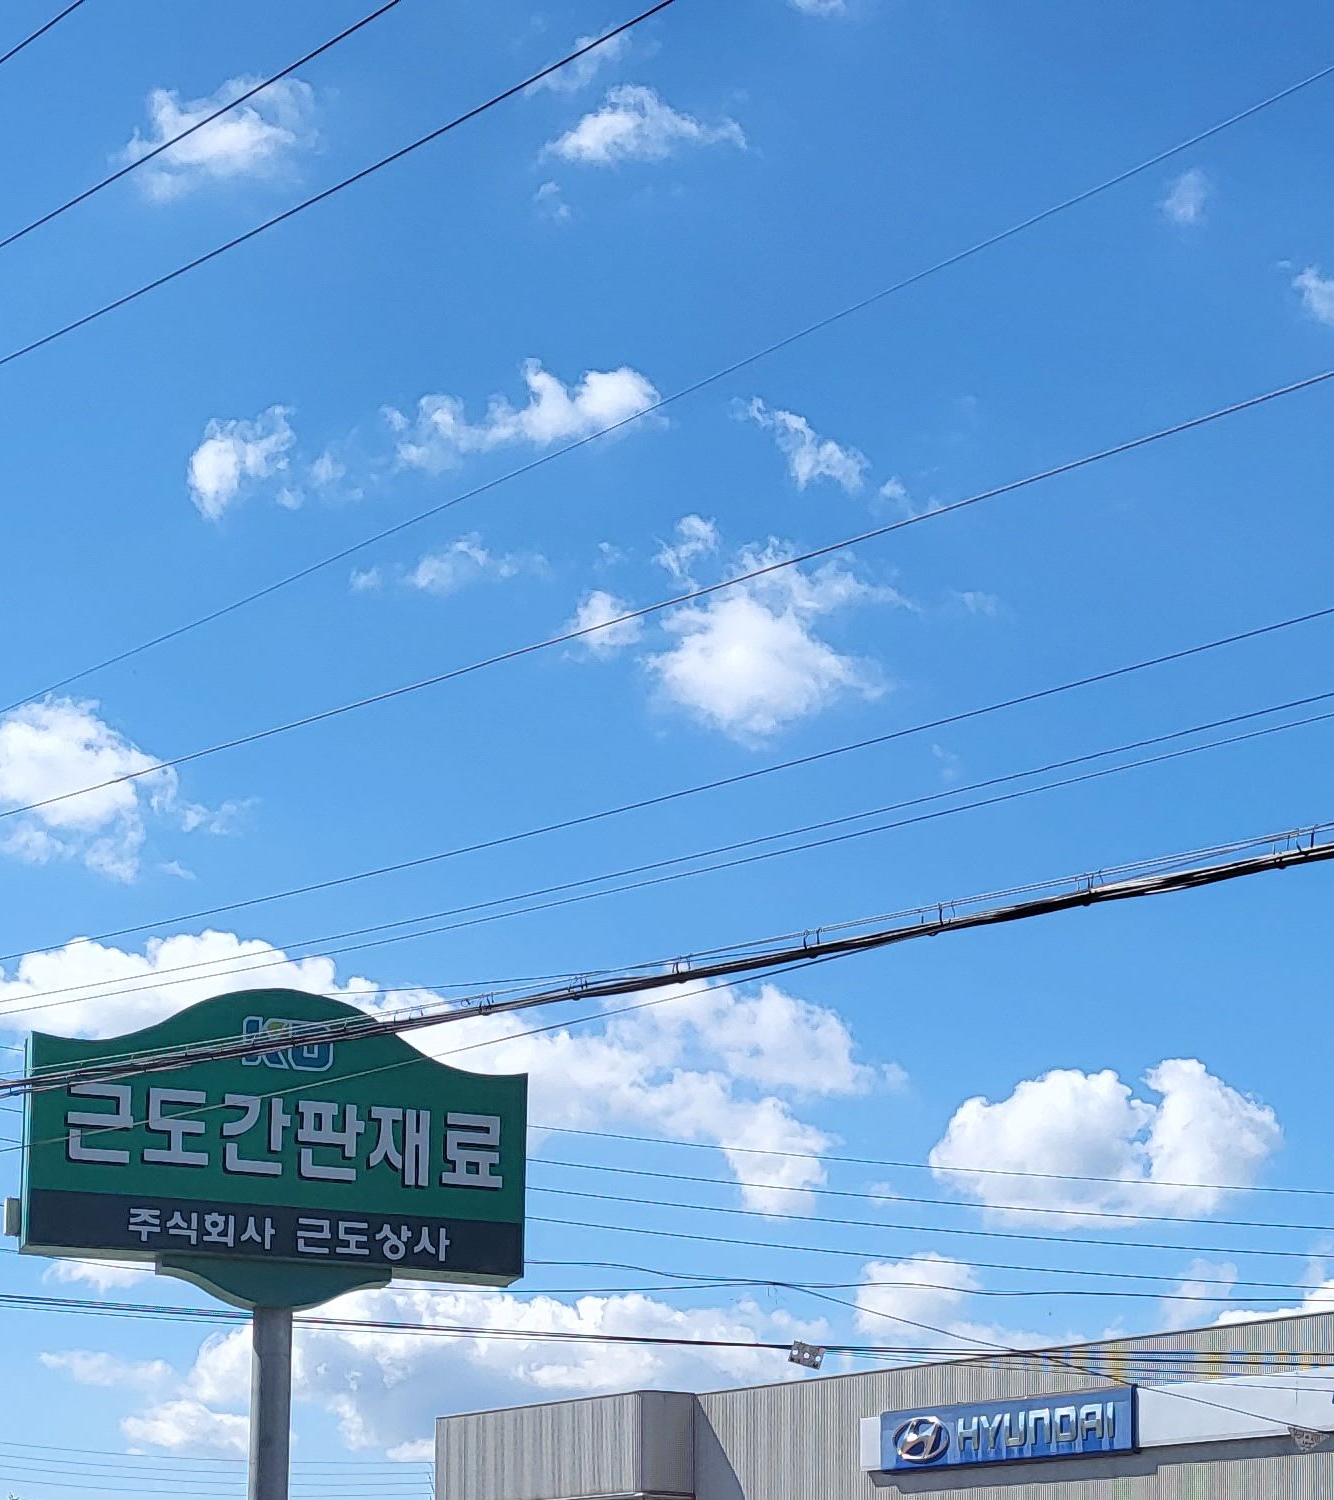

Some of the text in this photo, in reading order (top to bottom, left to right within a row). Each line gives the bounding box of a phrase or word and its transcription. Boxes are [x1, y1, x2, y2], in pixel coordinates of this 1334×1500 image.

[67, 1081, 503, 1188] 근도간판재료
[127, 1208, 450, 1263] 주식회사 근도상사
[957, 1402, 1115, 1450] HYUNDAI
